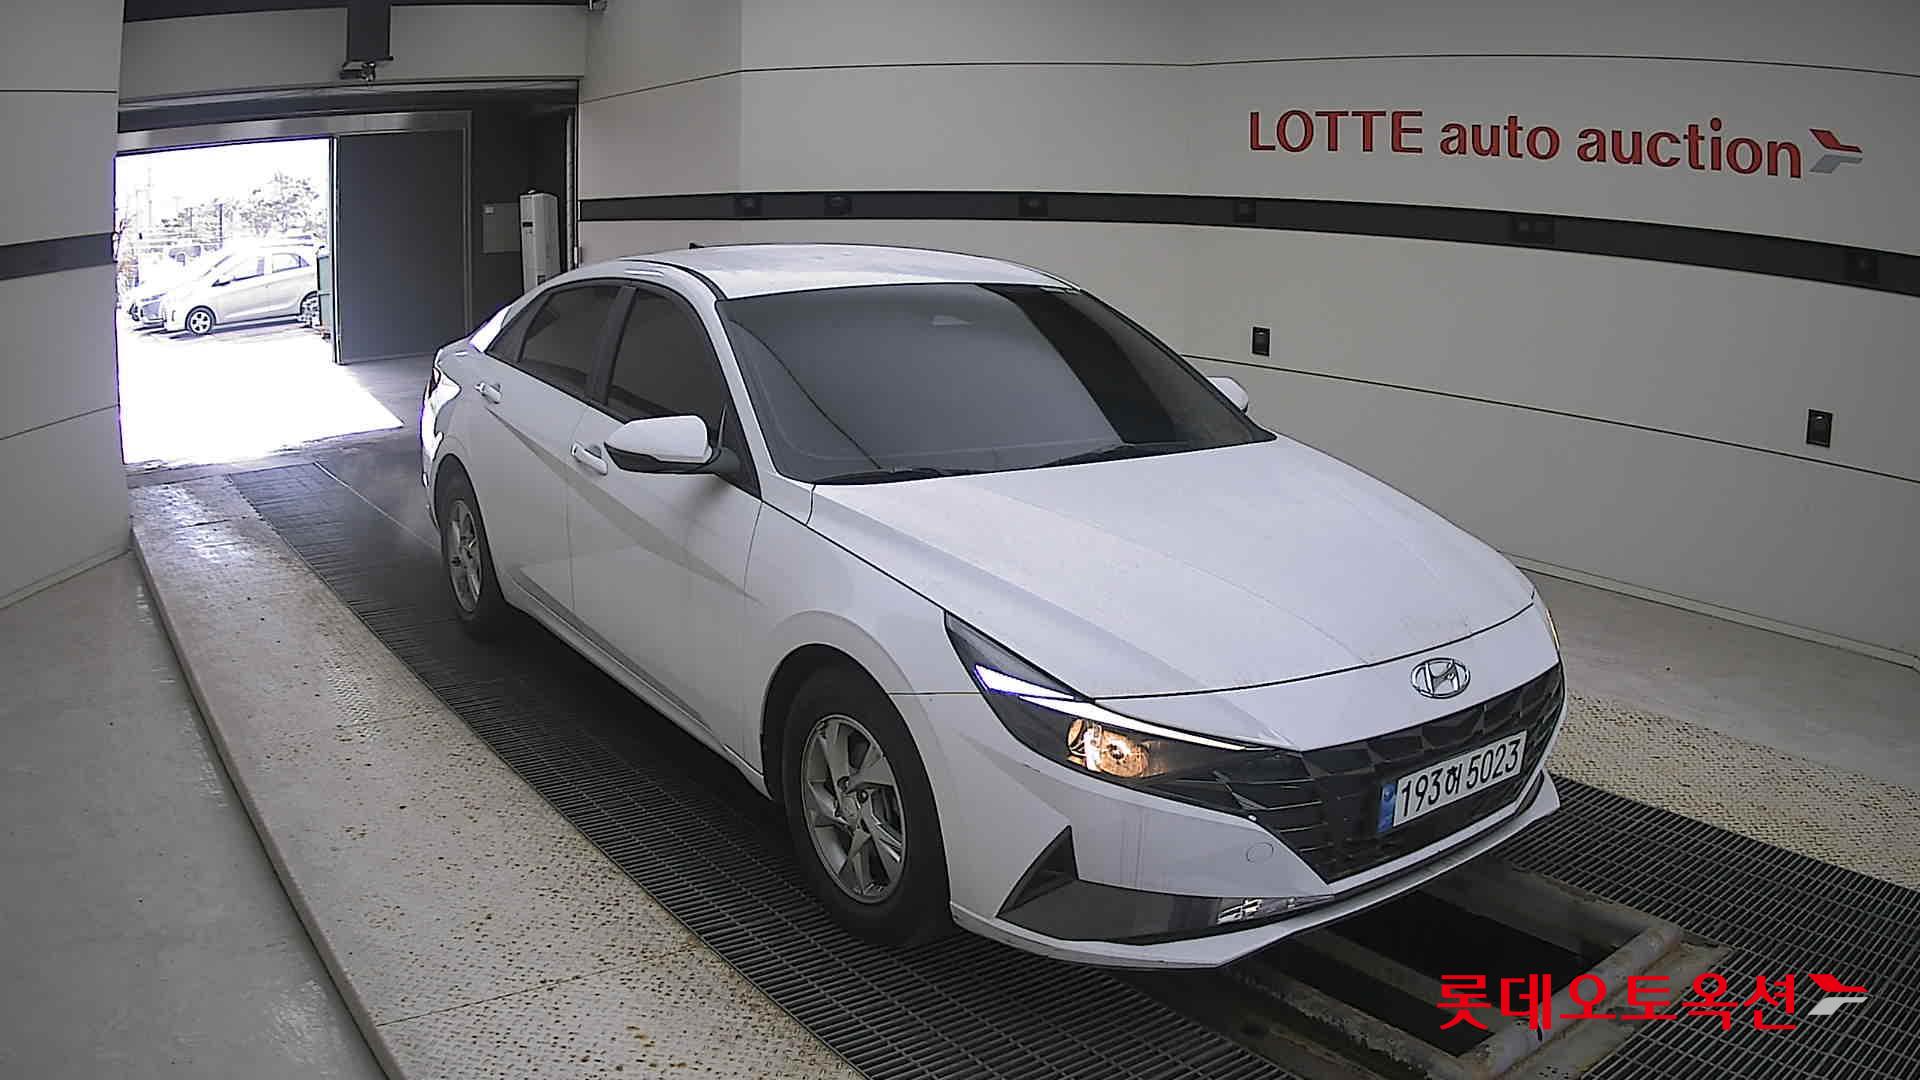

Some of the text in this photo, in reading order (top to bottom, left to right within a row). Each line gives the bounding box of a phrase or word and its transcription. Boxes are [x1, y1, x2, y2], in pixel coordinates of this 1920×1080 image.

[1249, 110, 1802, 179] LOTTE auto auction
